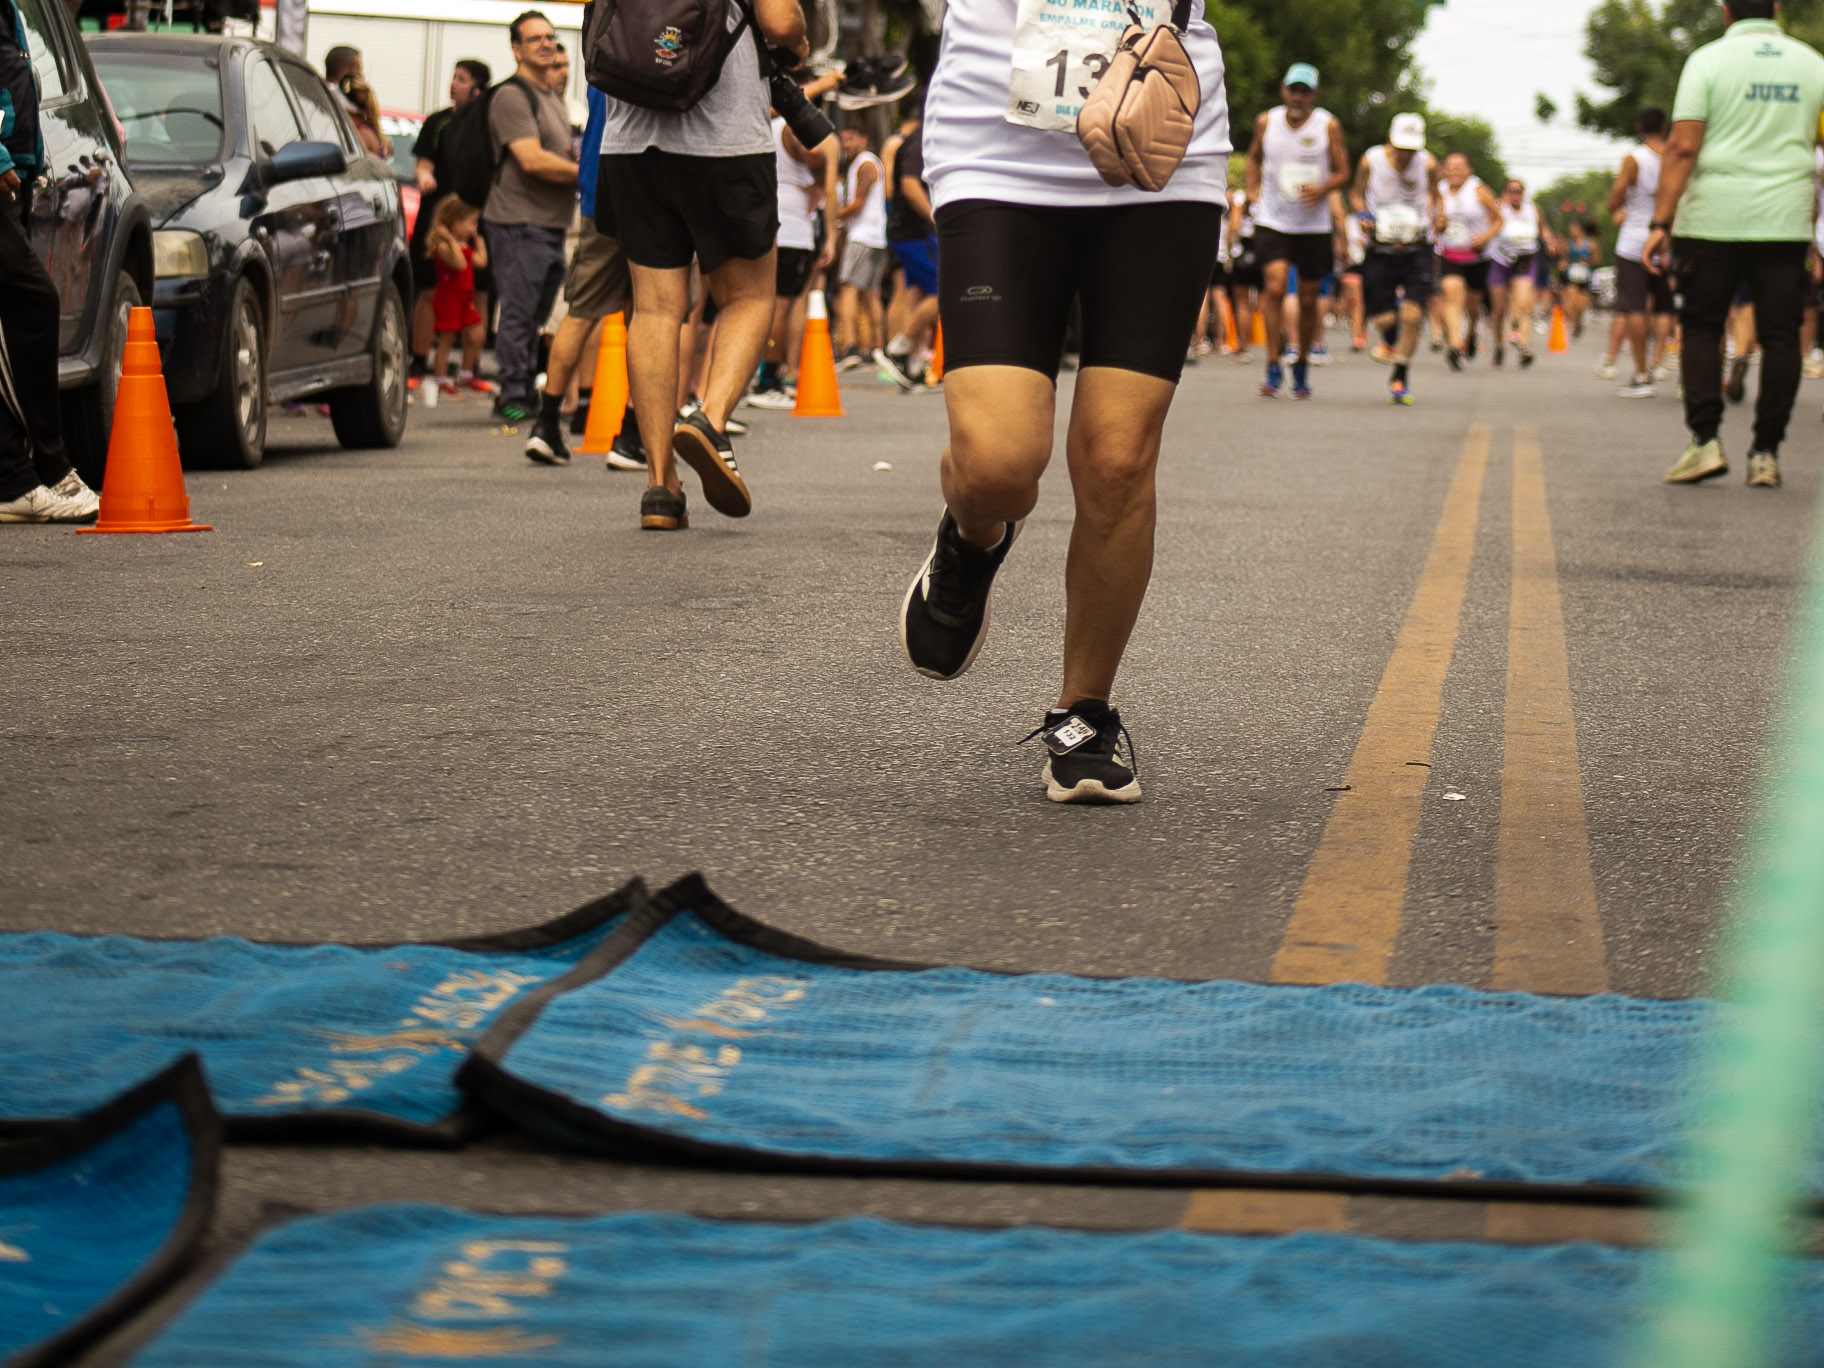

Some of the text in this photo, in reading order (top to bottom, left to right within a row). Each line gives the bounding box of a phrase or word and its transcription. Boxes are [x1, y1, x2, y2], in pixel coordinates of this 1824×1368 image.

[1040, 13, 1097, 28] EMPALME
[1745, 83, 1800, 103] JUEZ
[1016, 100, 1040, 114] NEJ
